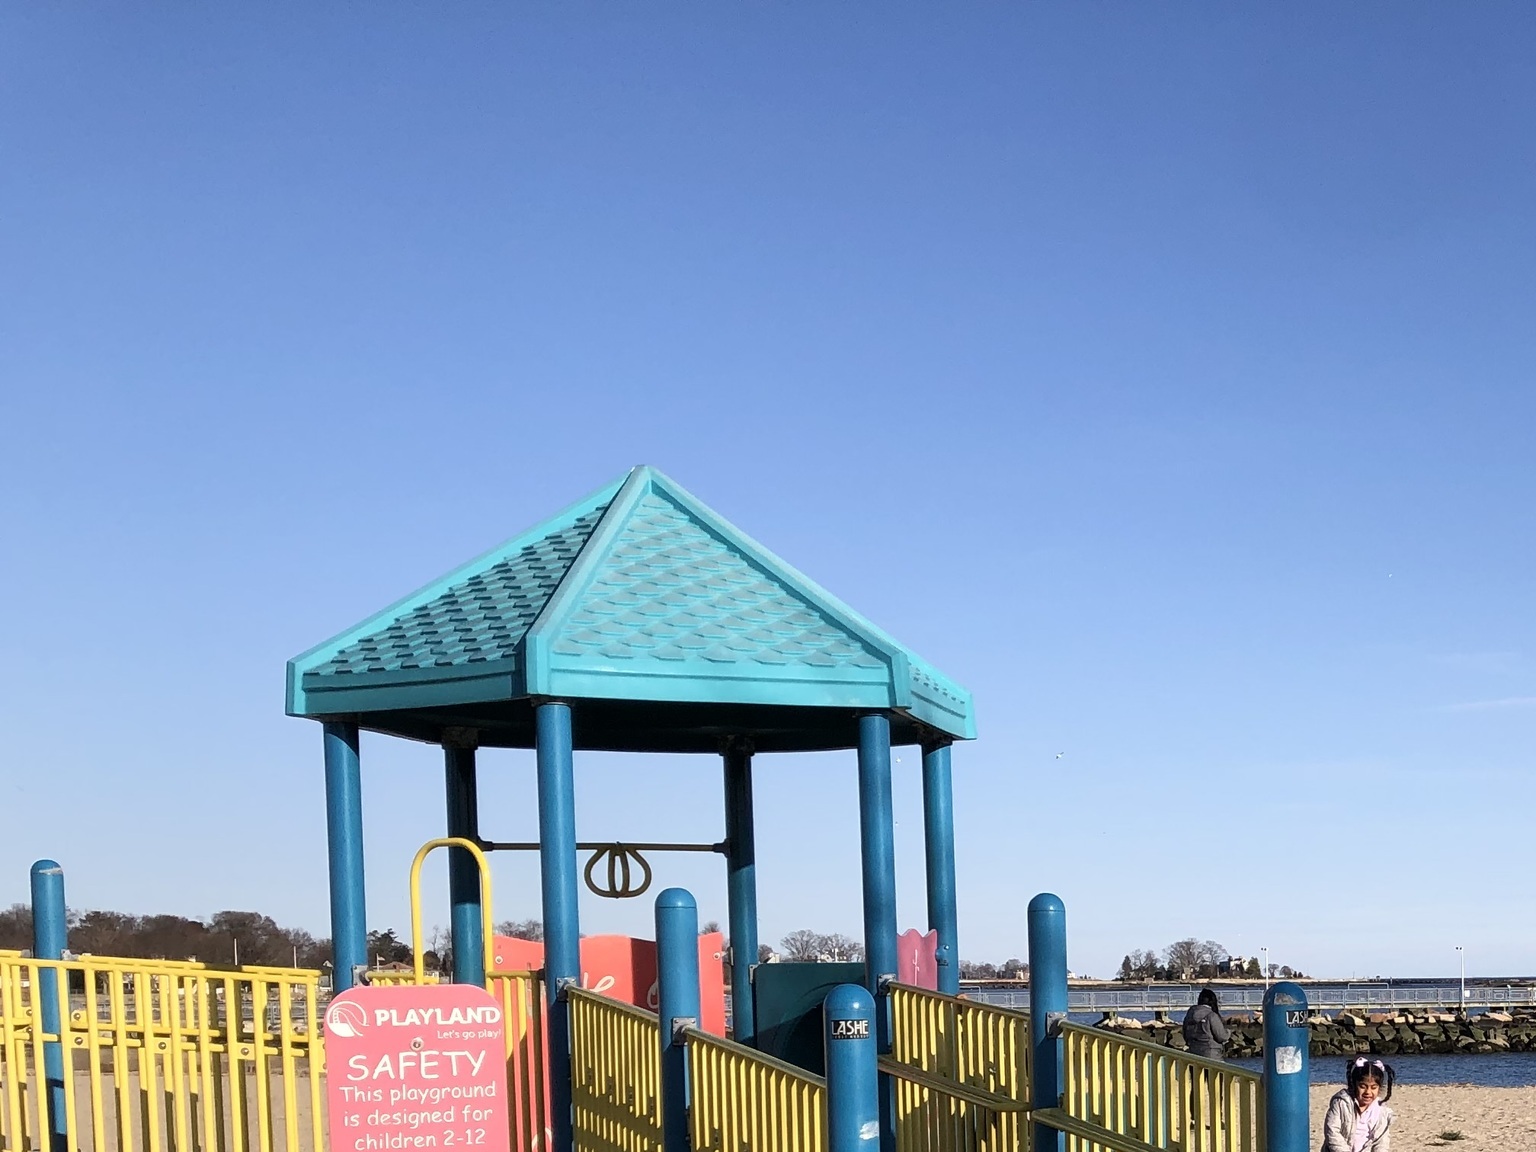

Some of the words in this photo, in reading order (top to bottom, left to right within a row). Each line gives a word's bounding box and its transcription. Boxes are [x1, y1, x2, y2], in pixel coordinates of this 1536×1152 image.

[374, 1006, 501, 1027] PLAYLAND
[437, 1028, 460, 1039] Let's
[462, 1031, 476, 1041] go
[478, 1028, 502, 1040] play!
[346, 1050, 486, 1081] SAFETY
[339, 1086, 383, 1103] This
[390, 1081, 496, 1105] playground
[344, 1112, 360, 1127] is
[367, 1106, 455, 1129] designed
[462, 1104, 493, 1122] for
[354, 1132, 437, 1151] children
[443, 1128, 486, 1146] 2-12
